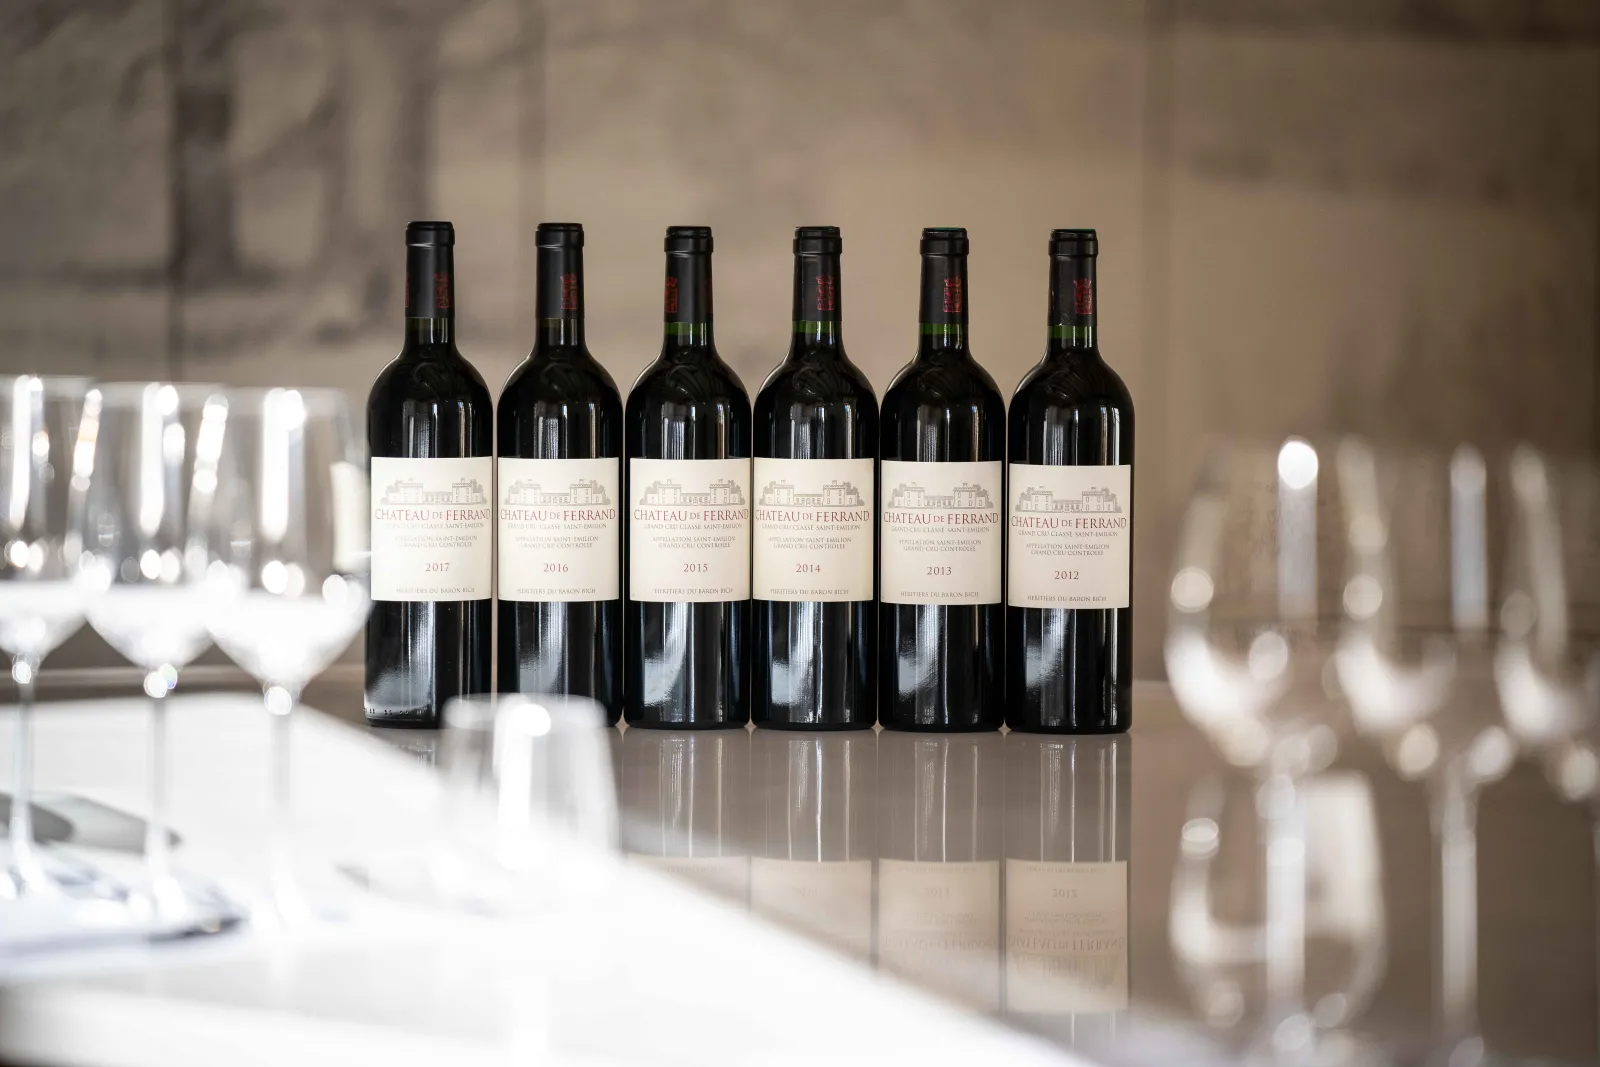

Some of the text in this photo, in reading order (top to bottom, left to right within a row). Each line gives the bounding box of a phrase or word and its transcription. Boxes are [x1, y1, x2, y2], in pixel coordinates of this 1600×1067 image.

[375, 508, 430, 521] CHATEAU
[446, 508, 490, 520] FERRAND
[501, 509, 547, 521] CHATEAU
[564, 509, 616, 521] FERRAND
[634, 509, 687, 521] CHATEAU
[704, 509, 748, 521] FERRAND
[755, 510, 799, 521] CHATEAU
[816, 510, 870, 522] FERRAND
[884, 512, 930, 524] CHATEAU
[948, 512, 998, 524] FERRAND
[1011, 516, 1058, 528] CHATEAU
[1076, 517, 1126, 528] FERRAND
[425, 562, 450, 572] 2017
[543, 563, 569, 572] 2016
[684, 563, 708, 572] 2015
[796, 563, 820, 572] 2014
[927, 566, 952, 575] 2013
[1054, 571, 1079, 580] 2012
